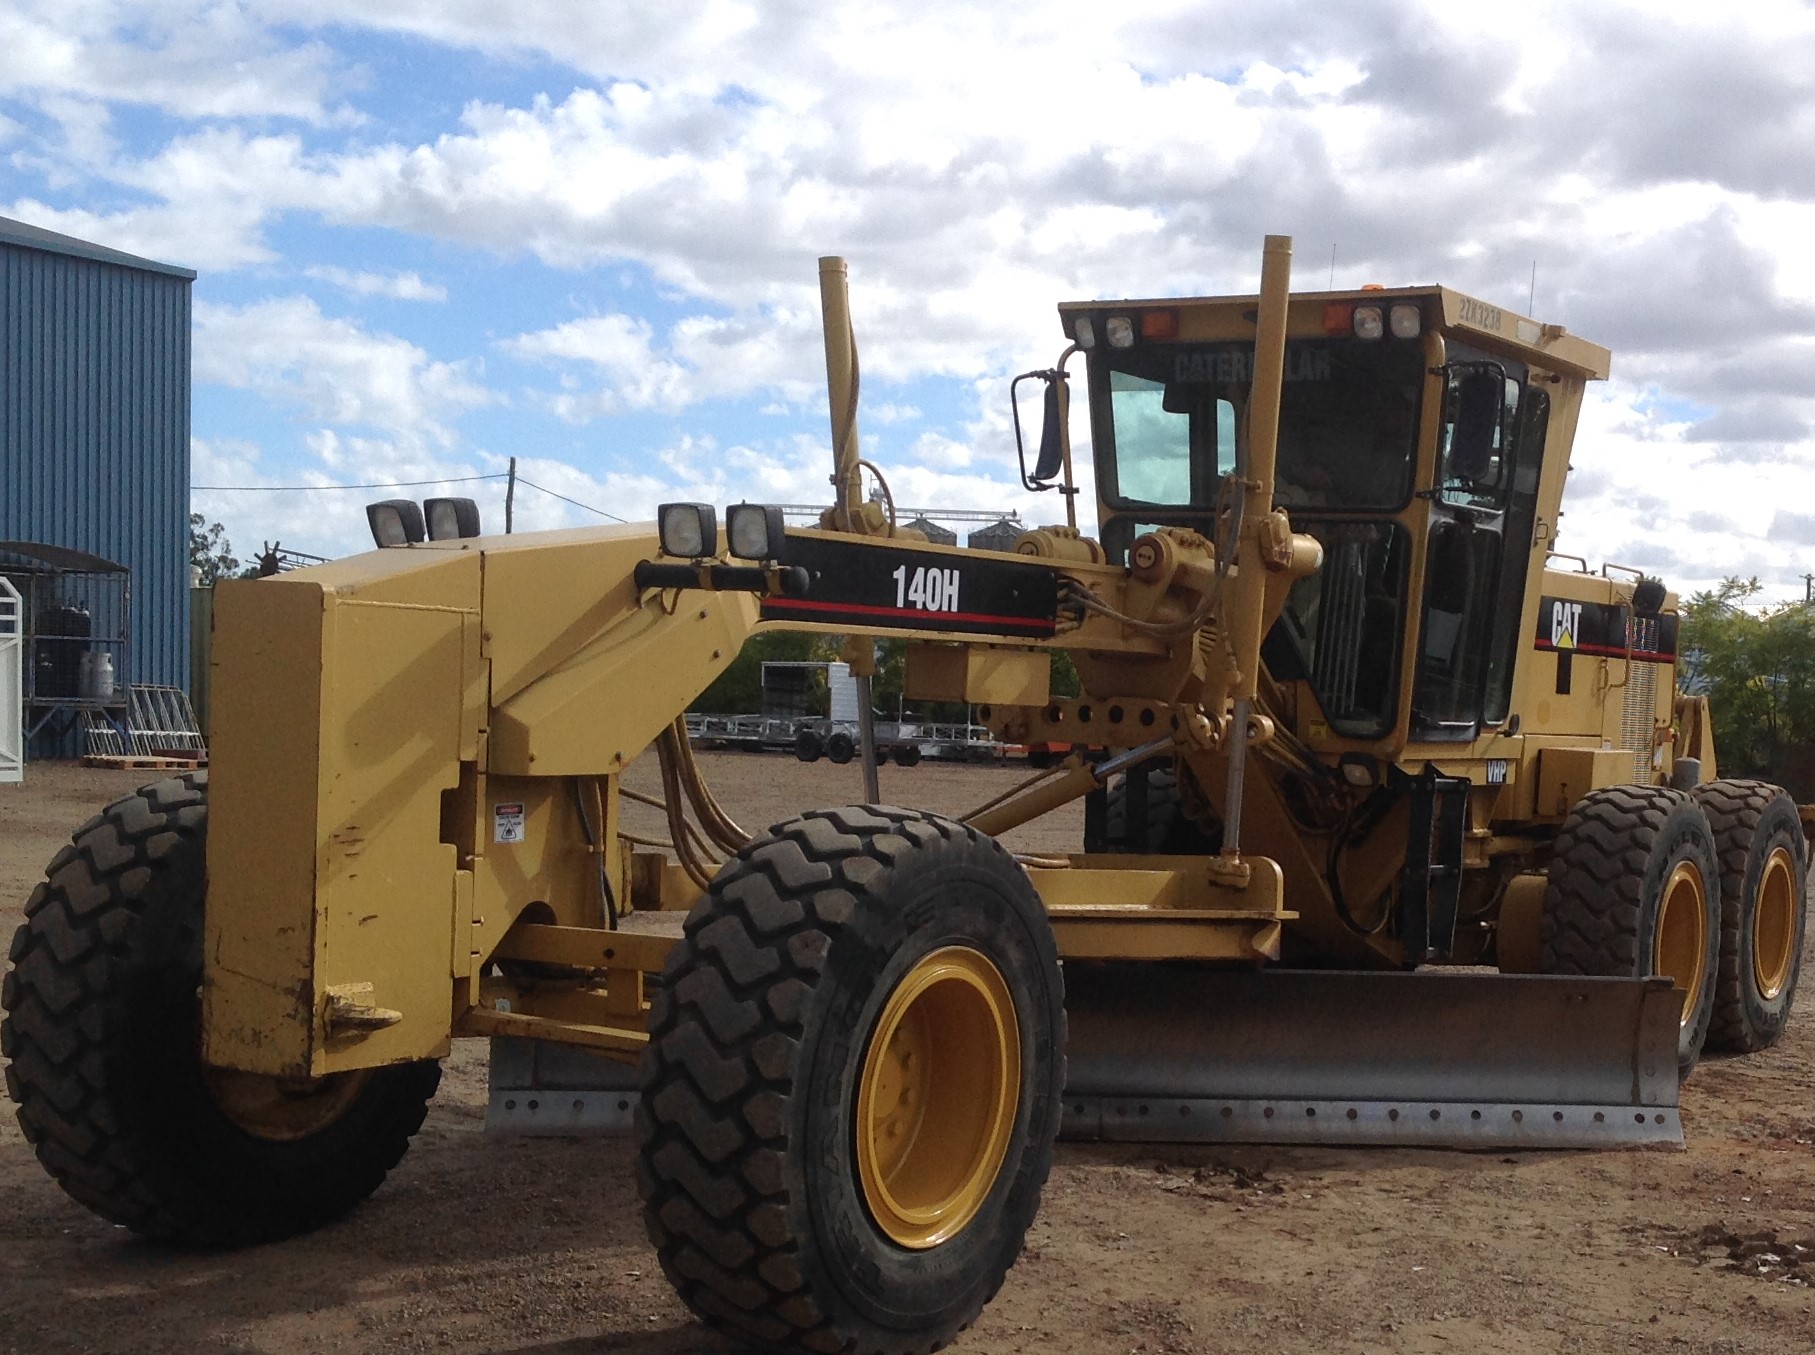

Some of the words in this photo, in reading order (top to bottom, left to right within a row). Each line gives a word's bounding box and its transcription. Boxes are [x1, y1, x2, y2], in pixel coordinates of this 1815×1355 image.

[1174, 348, 1331, 382] CATERLAR
[893, 565, 960, 612] 140H
[1551, 601, 1582, 648] CAT
[1487, 760, 1507, 783] VHP
